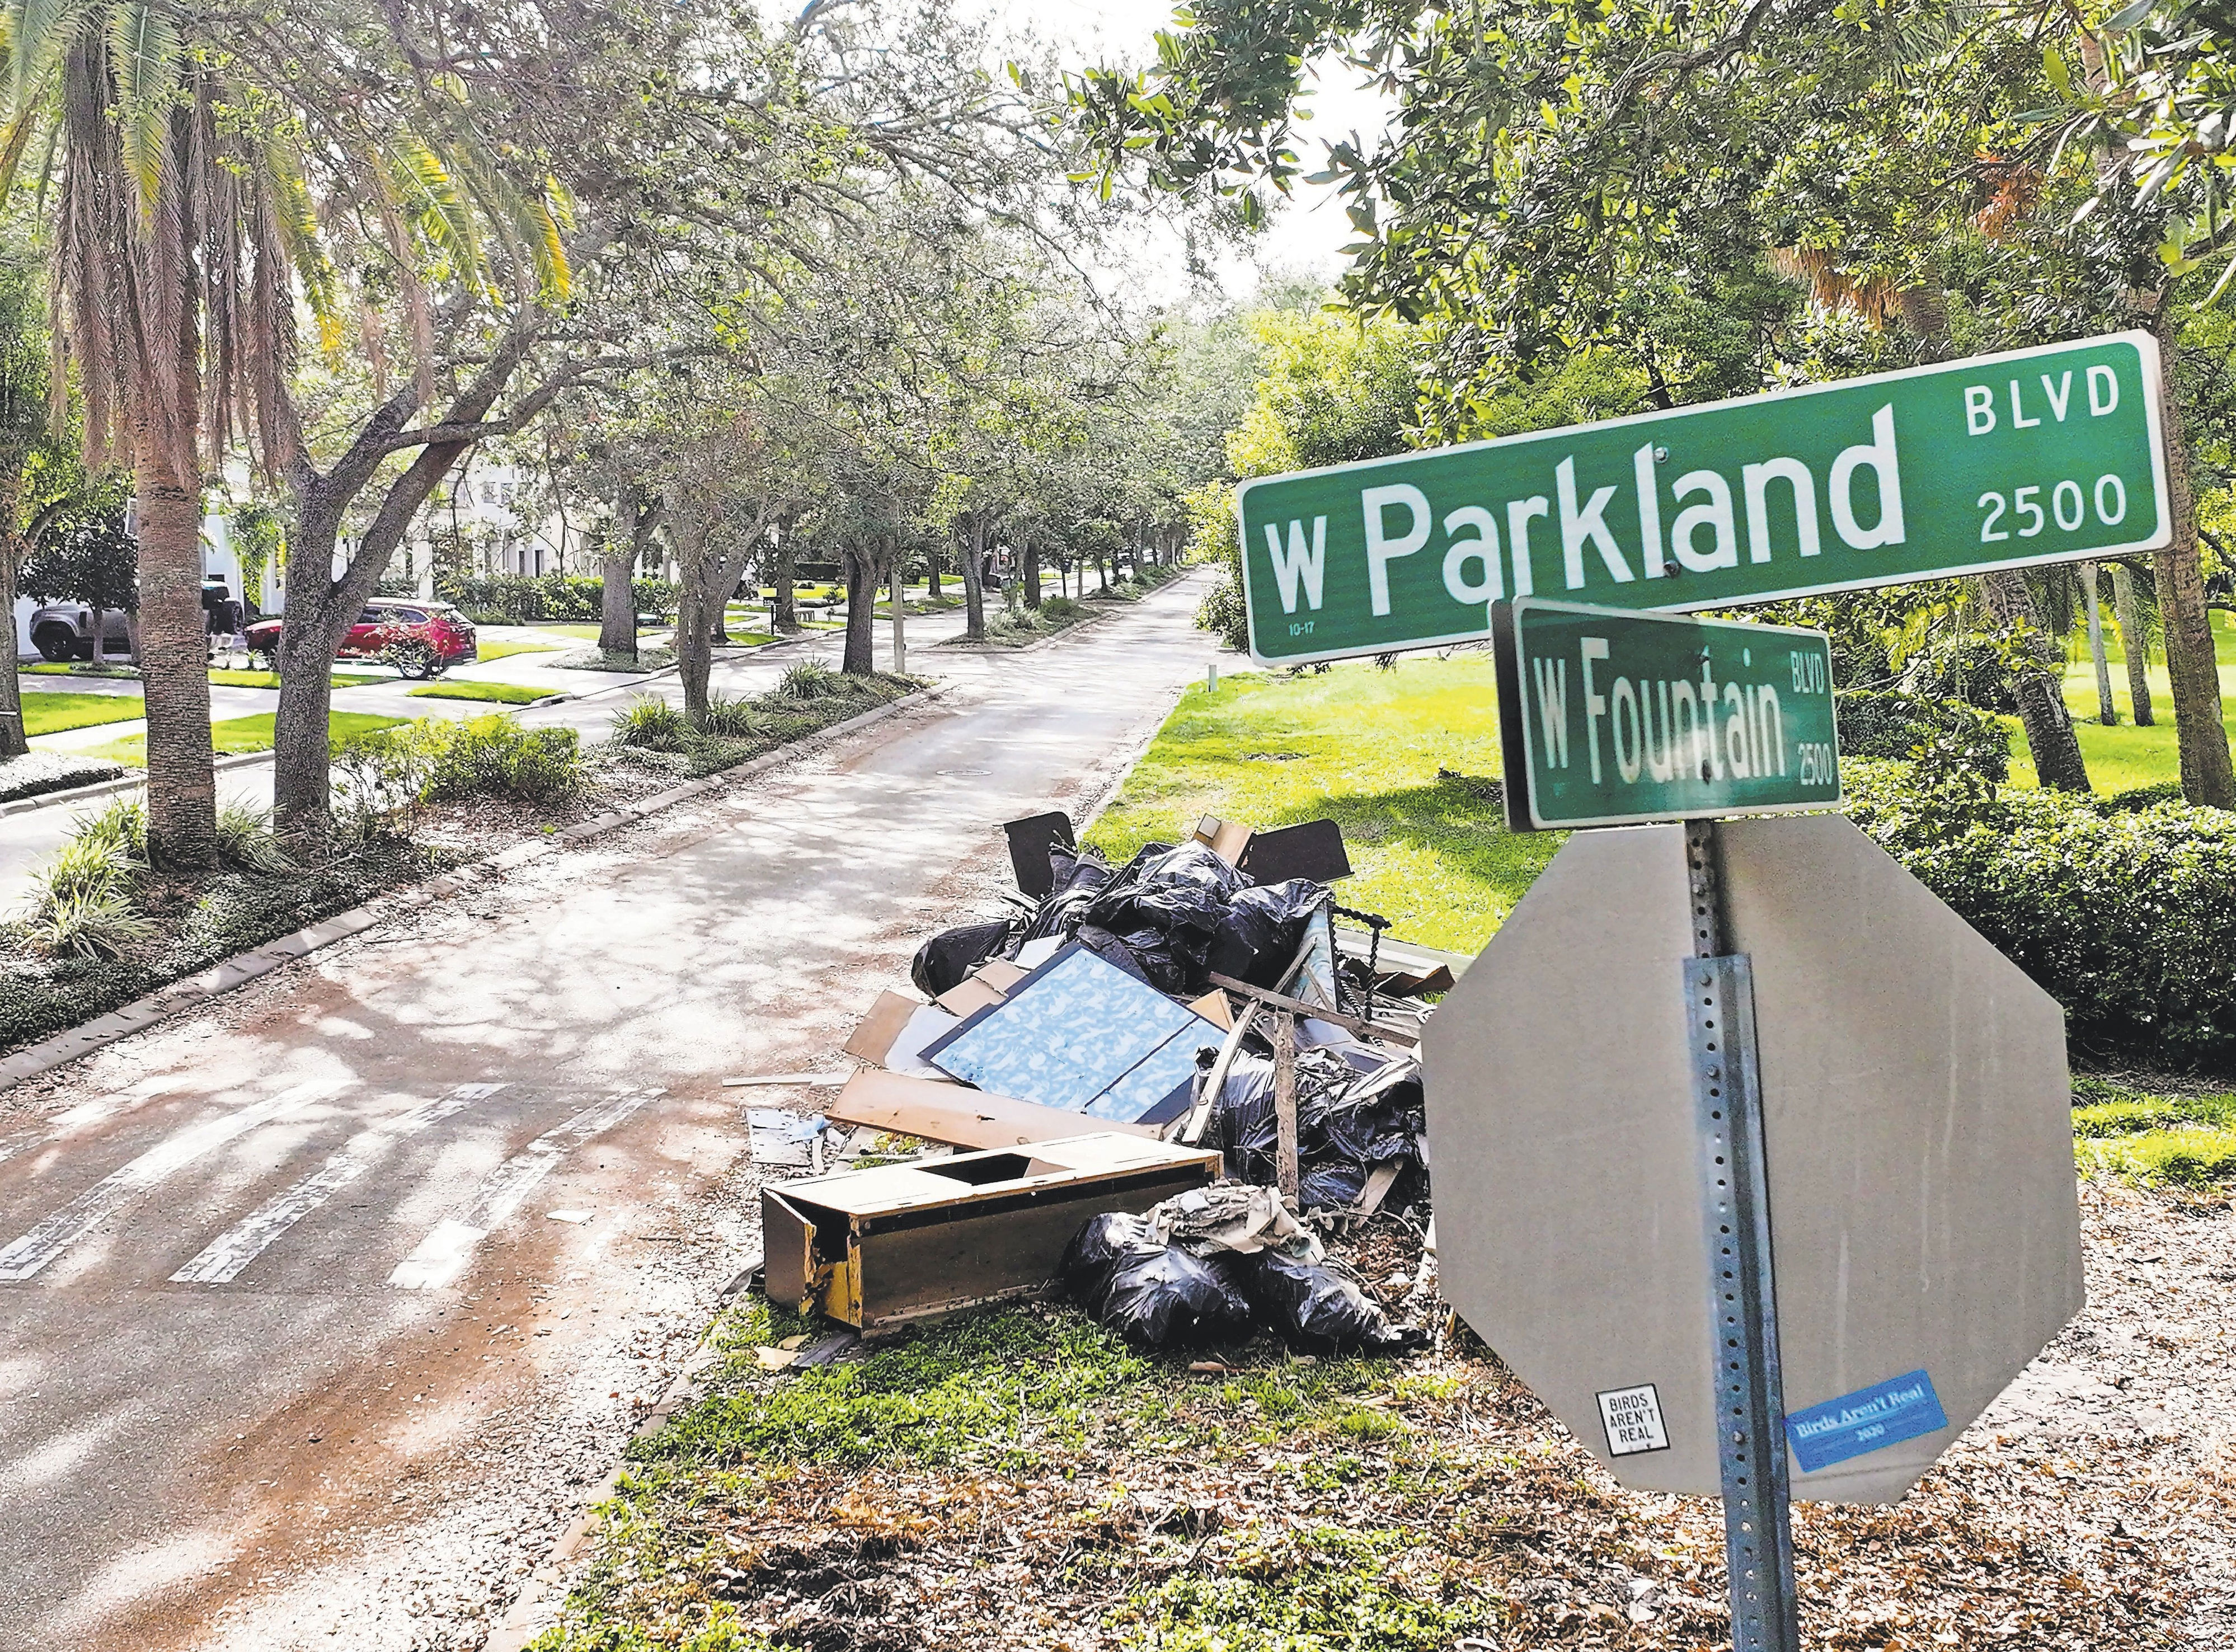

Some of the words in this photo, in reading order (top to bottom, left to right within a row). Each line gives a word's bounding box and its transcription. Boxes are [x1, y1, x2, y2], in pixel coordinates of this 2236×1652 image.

[1964, 364, 2120, 437] BLVD
[1263, 515, 1328, 615] W
[1361, 402, 1906, 617] Parkland
[1977, 473, 2127, 543] 2500
[1289, 621, 1315, 636] 10-17
[1791, 651, 1825, 694] BLVD
[1534, 657, 1568, 768] W
[1581, 637, 1786, 784] Fountain
[1798, 743, 1833, 785] 2500
[1609, 1393, 1648, 1411] BIRDS
[1610, 1409, 1654, 1428] AREN'T
[1796, 1415, 1839, 1438] Birds
[1887, 1383, 1924, 1406] Real
[1619, 1425, 1654, 1443] REAL
